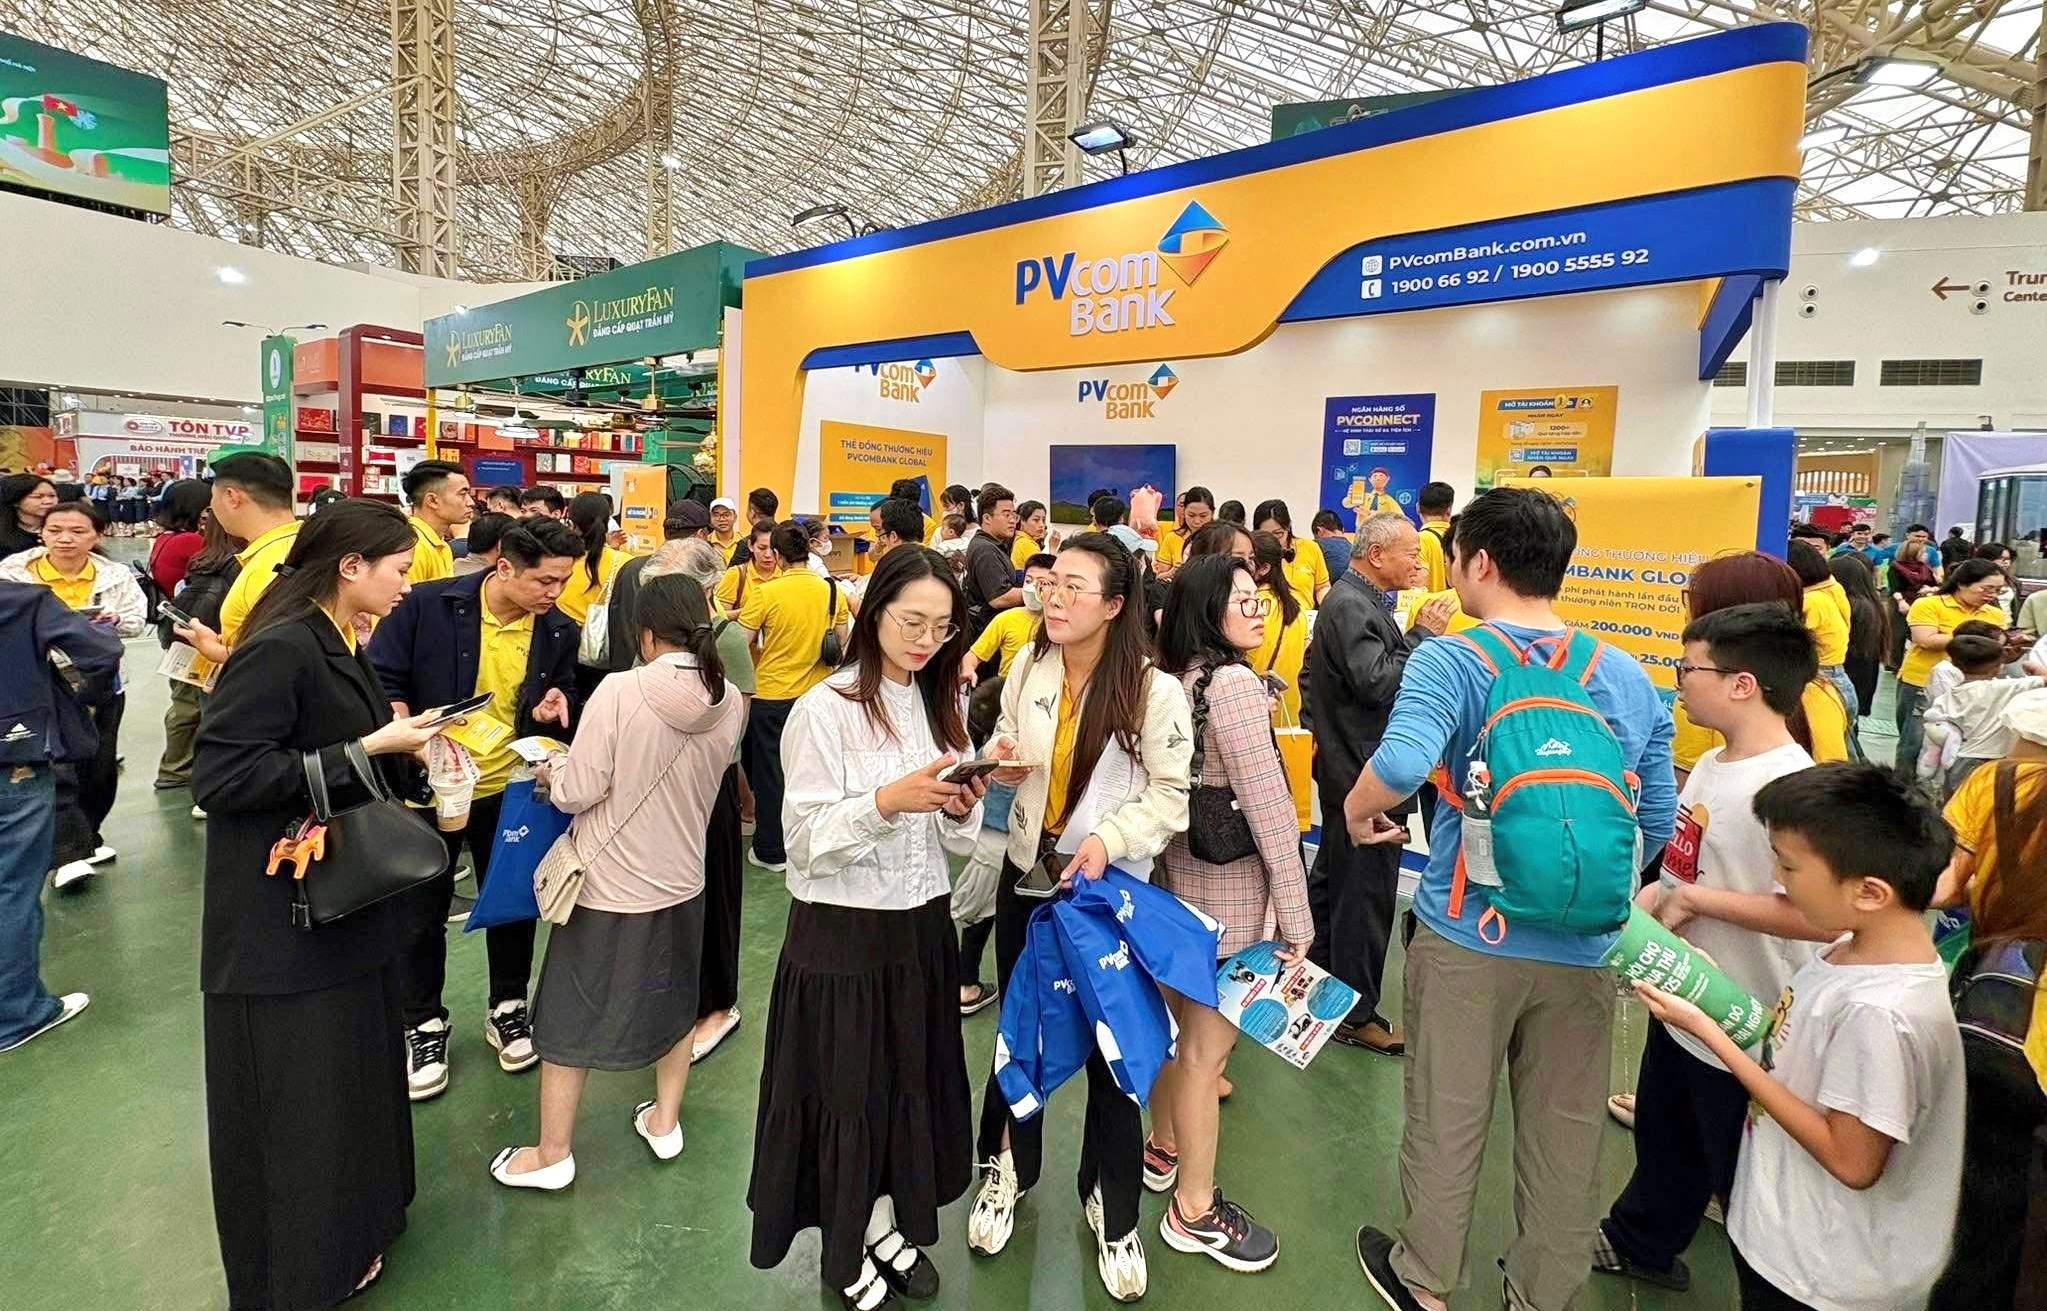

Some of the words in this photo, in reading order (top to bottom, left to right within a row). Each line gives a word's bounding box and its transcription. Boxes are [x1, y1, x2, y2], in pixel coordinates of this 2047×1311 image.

[1389, 231, 1587, 270] PVcomBank.com.vn
[1015, 251, 1158, 305] PVcom
[1392, 277, 1434, 294] 1900
[1438, 273, 1461, 287] 66
[1466, 269, 1490, 284] 92
[1511, 260, 1560, 279] 1900
[1564, 254, 1616, 272] 5555
[1621, 248, 1650, 264] 92
[1069, 289, 1177, 336] Bank
[585, 367, 631, 384] RYFAN
[880, 379, 920, 402] Bank
[1078, 379, 1149, 403] PVcom
[1105, 401, 1155, 419] Bank
[1336, 414, 1421, 426] PVCONNECT
[168, 420, 208, 434] TÔN
[847, 453, 897, 464] PVCOMBANK
[899, 457, 927, 466] GLOBAL
[1565, 565, 1634, 582] MBANK
[1640, 570, 1689, 586] GLO
[1565, 585, 1580, 595] phí
[1591, 620, 1652, 637] 200.000
[1655, 630, 1680, 641] VND
[1669, 831, 1694, 857] LLO
[1655, 946, 1677, 971] THU
